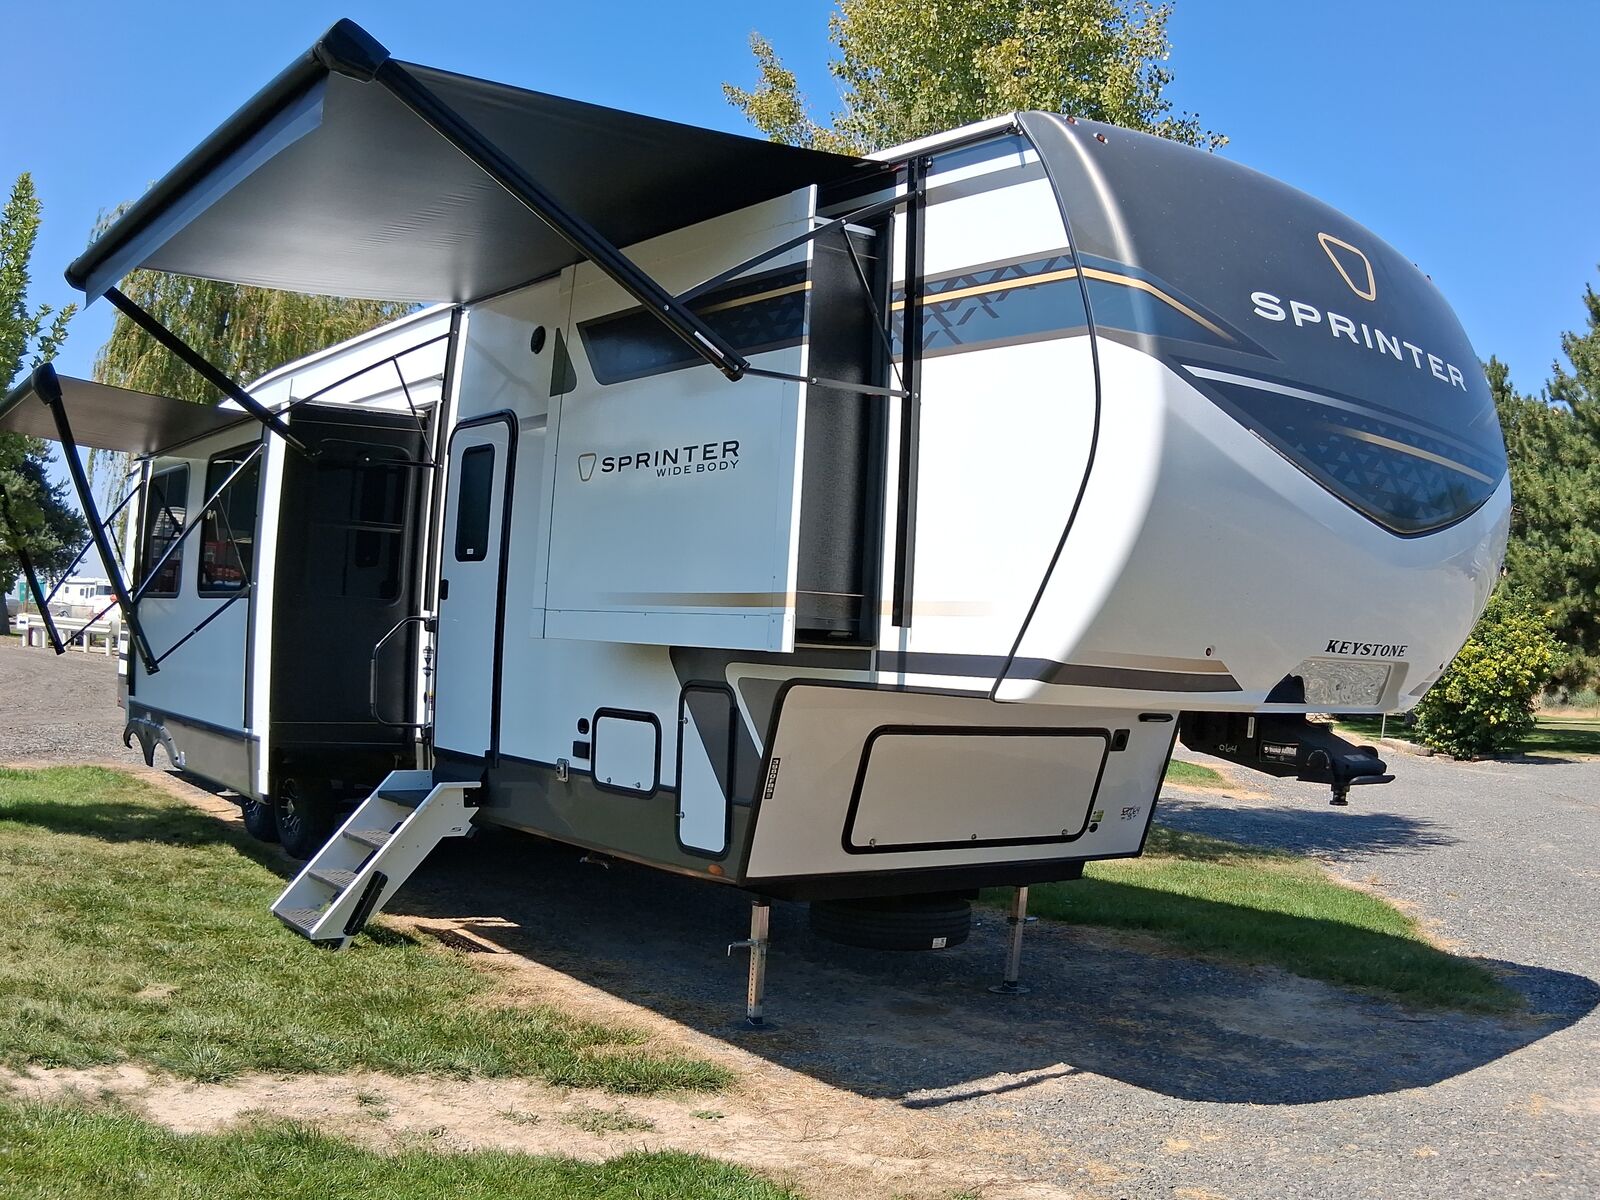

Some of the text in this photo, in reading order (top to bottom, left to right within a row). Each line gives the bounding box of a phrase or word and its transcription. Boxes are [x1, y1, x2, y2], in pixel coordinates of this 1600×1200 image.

[1250, 291, 1468, 392] SPRINTER
[601, 440, 740, 473] SPRINTER
[656, 459, 740, 477] WIDE BODY
[1325, 639, 1409, 657] KEYSTONE
